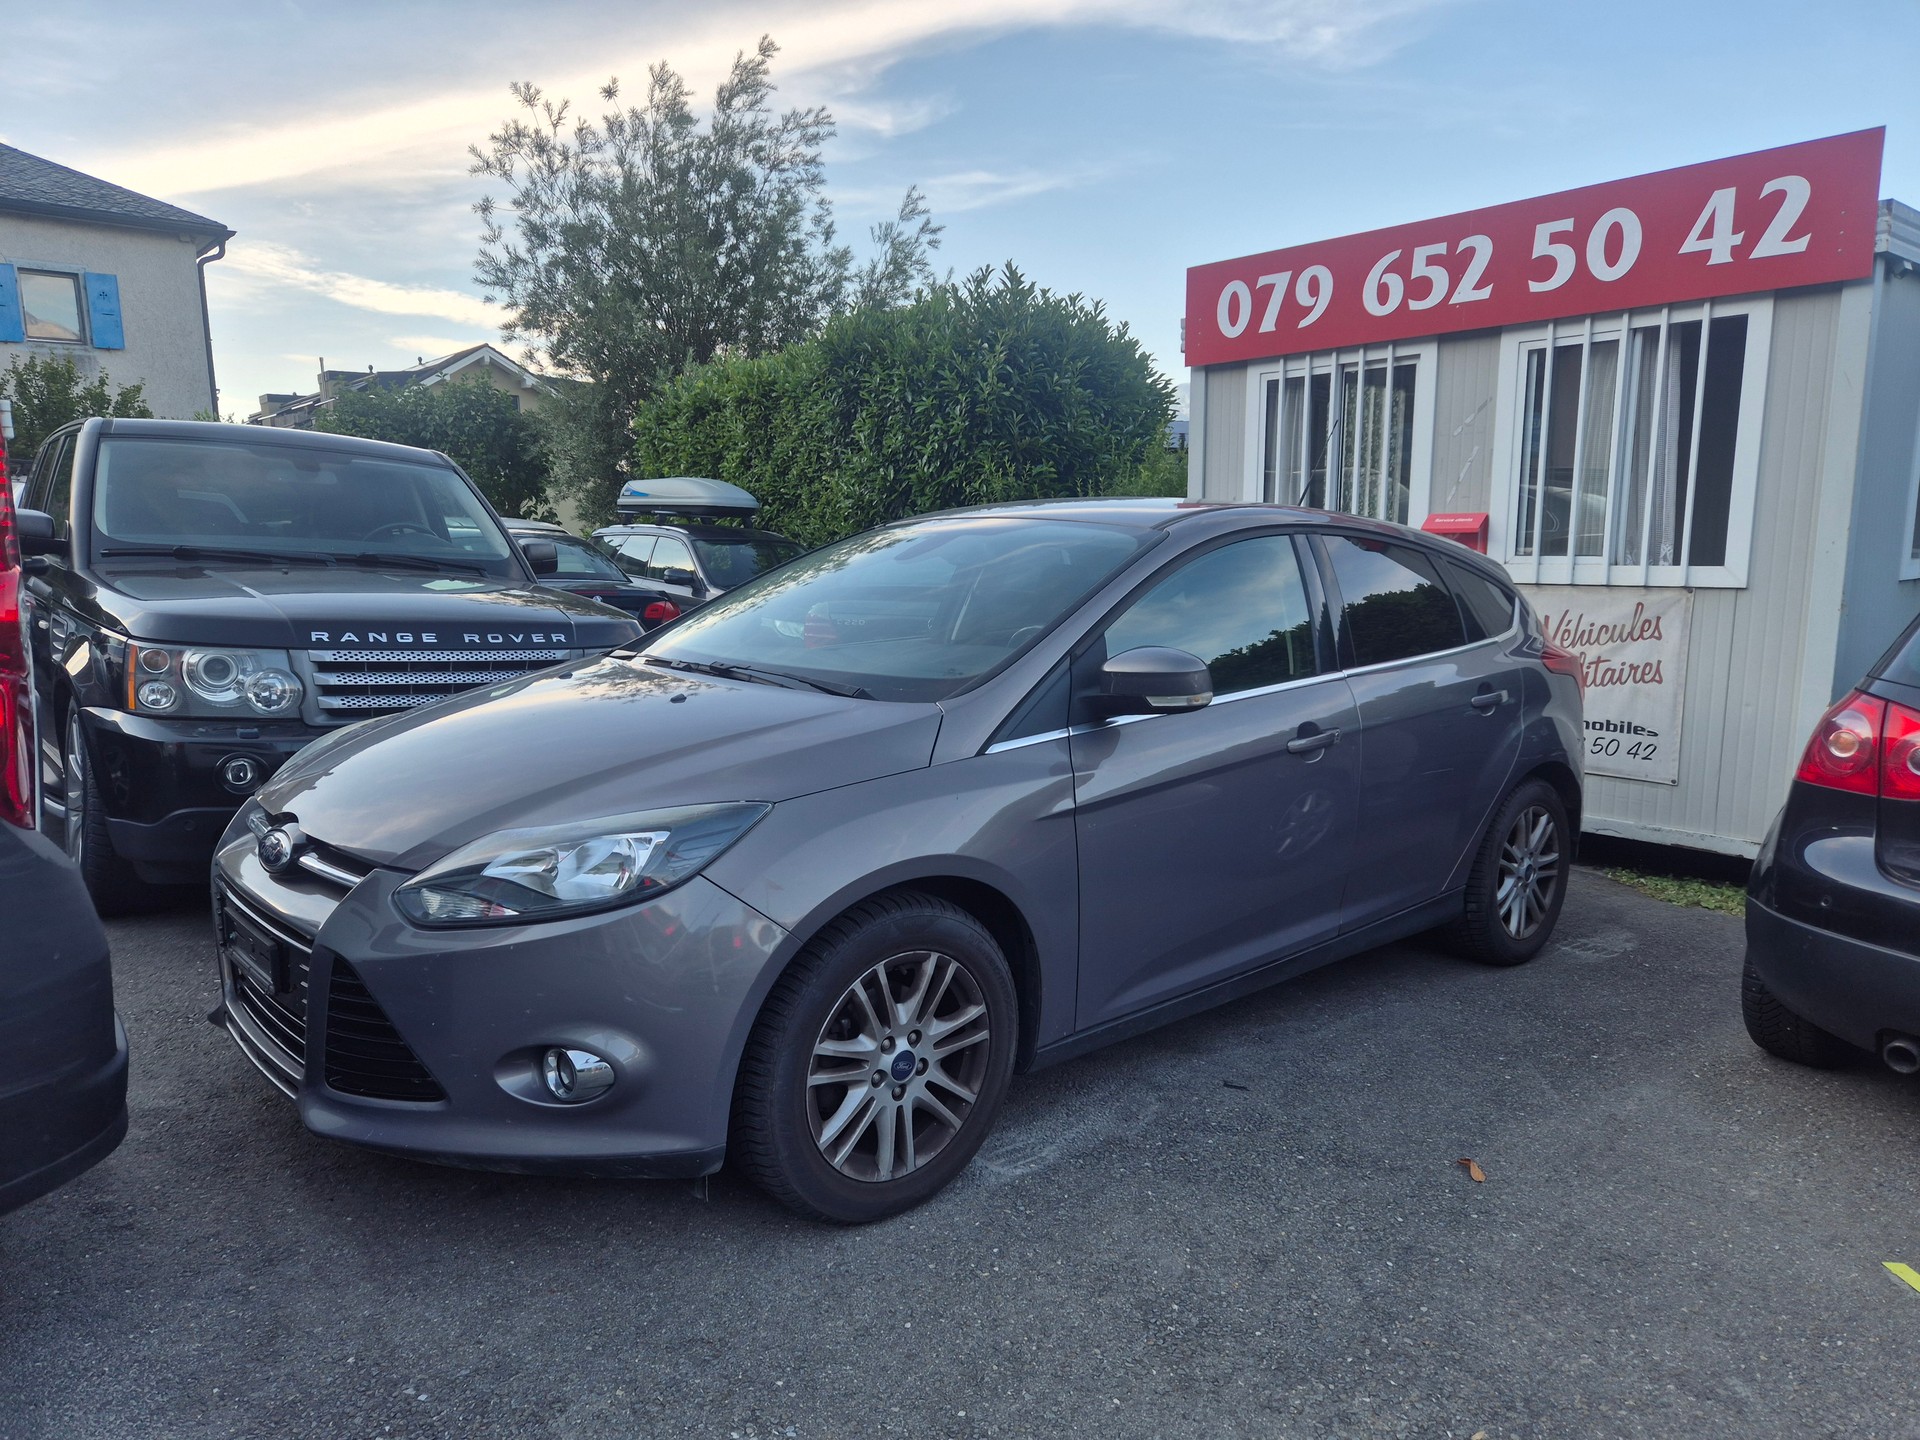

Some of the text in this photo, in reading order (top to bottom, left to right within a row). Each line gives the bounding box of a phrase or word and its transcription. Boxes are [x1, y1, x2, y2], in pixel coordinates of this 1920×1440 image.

[1216, 174, 1813, 339] 079 652 50 42
[310, 631, 567, 643] RANGE ROVER
[1544, 602, 1663, 649] Véhicules
[1590, 736, 1657, 761] 50 42
